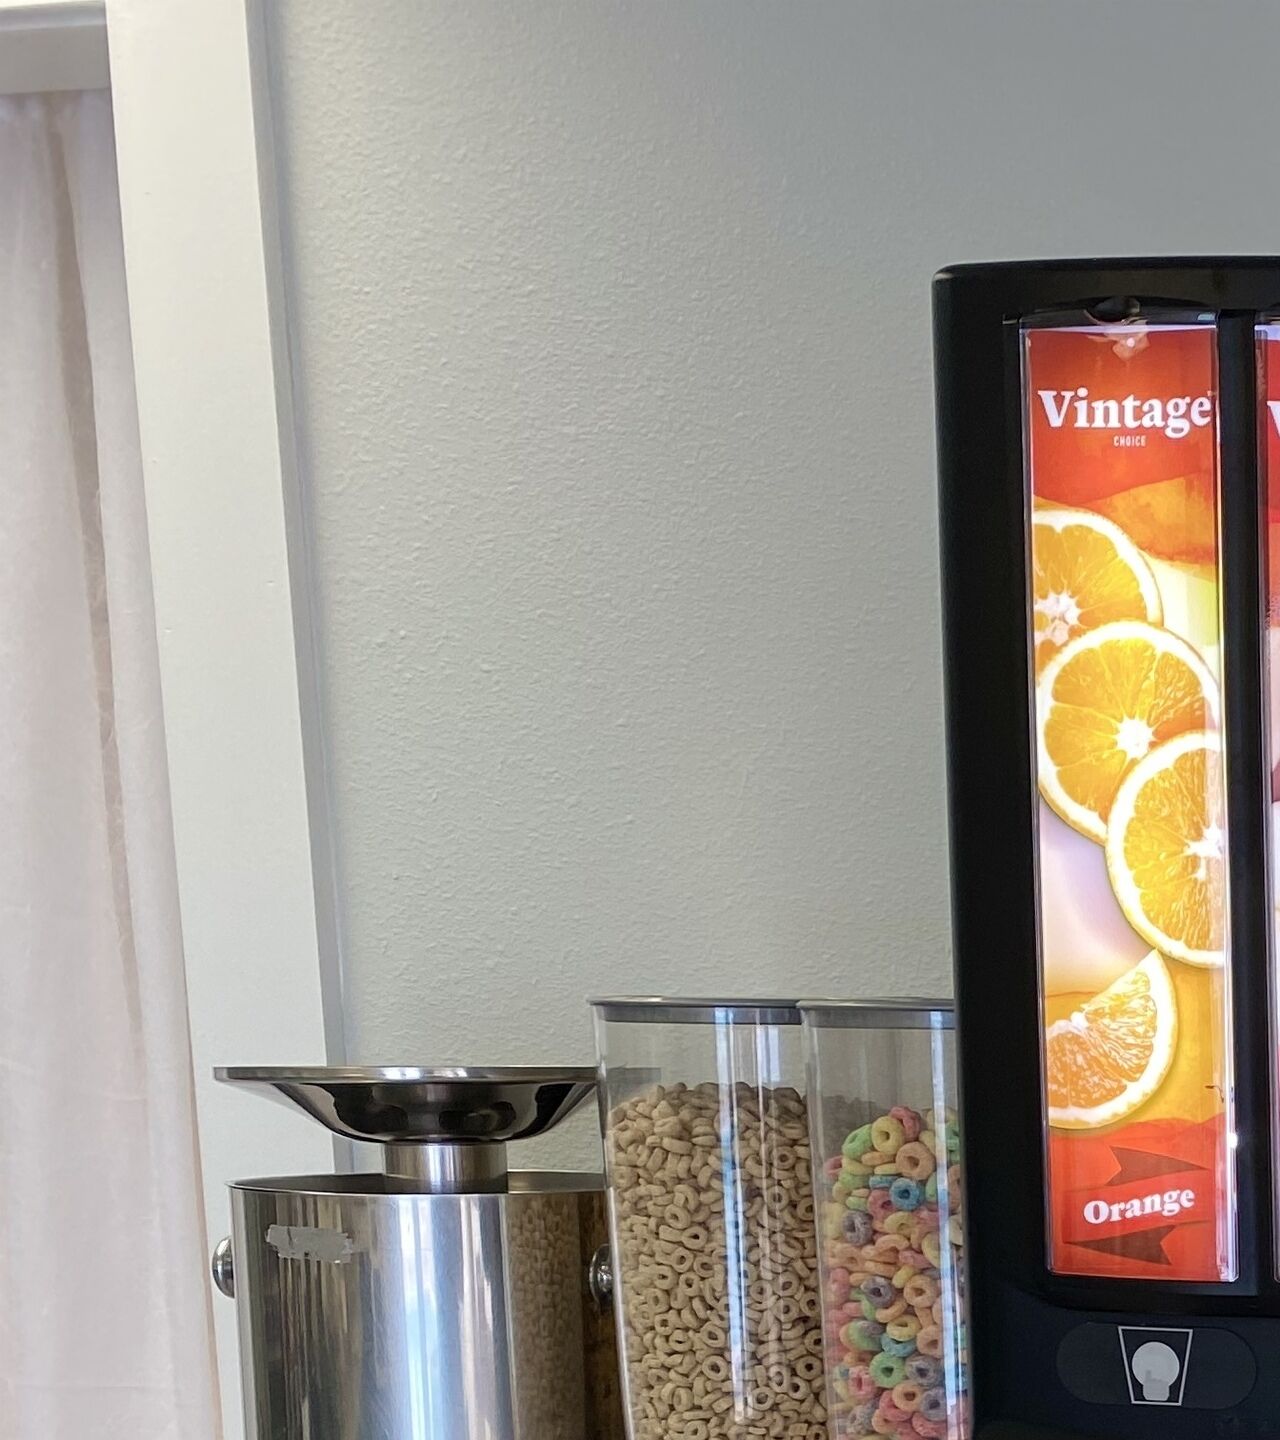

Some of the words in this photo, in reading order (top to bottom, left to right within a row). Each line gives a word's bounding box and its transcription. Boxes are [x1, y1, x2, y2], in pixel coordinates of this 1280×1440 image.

[1037, 387, 1211, 438] Vintage
[1113, 434, 1147, 447] CHOICE
[1083, 1187, 1195, 1225] Orange
